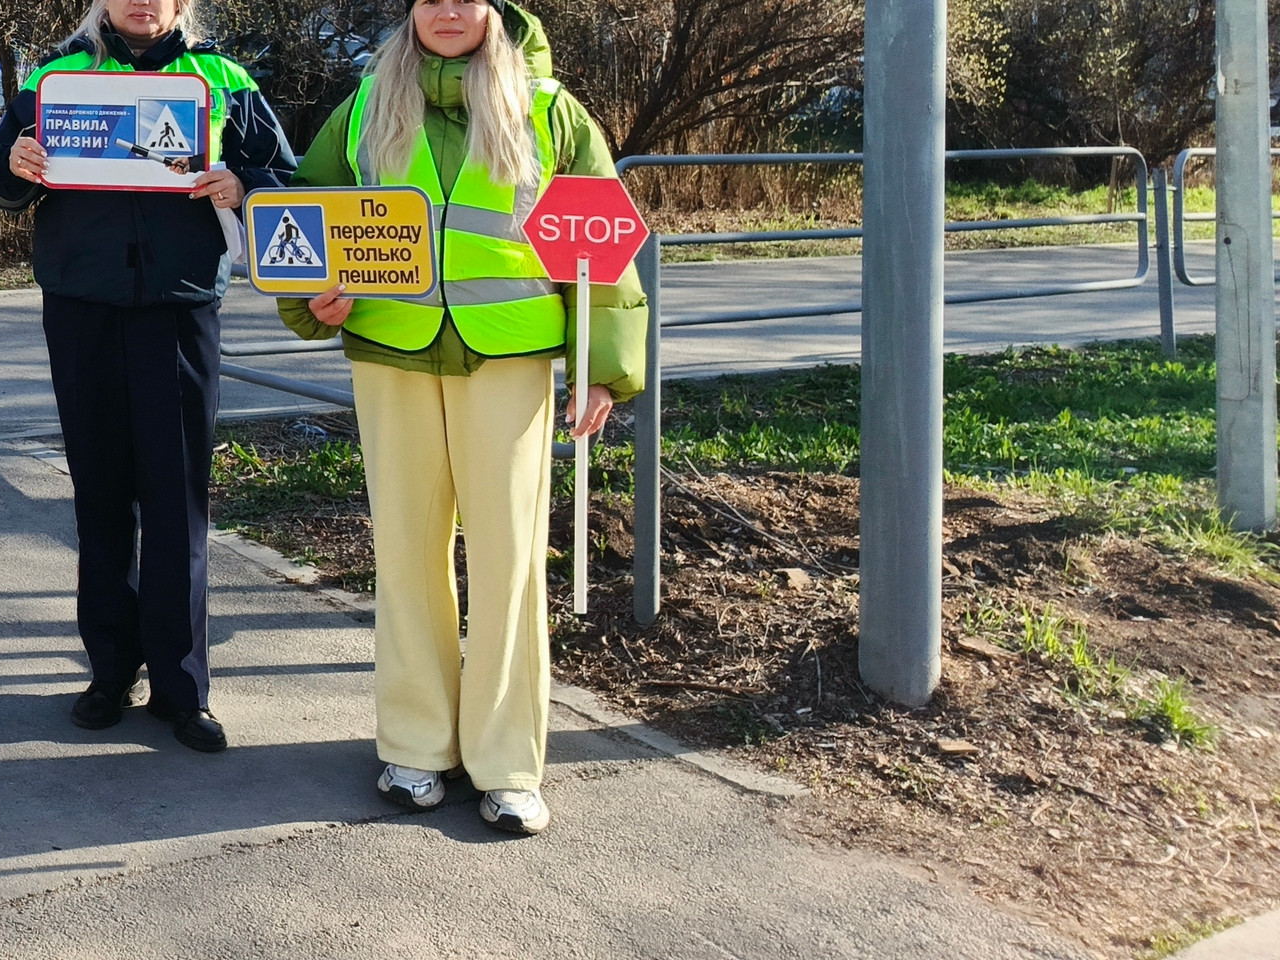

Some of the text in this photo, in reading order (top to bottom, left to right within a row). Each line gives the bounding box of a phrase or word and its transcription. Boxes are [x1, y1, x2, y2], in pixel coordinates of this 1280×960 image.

[45, 119, 109, 131] ПРАВИЛА
[46, 135, 109, 149] ЖИЗНИ!
[360, 198, 388, 217] По
[330, 225, 422, 244] переходу
[538, 214, 637, 244] STOP
[343, 247, 412, 262] только
[339, 265, 420, 284] пешком!
